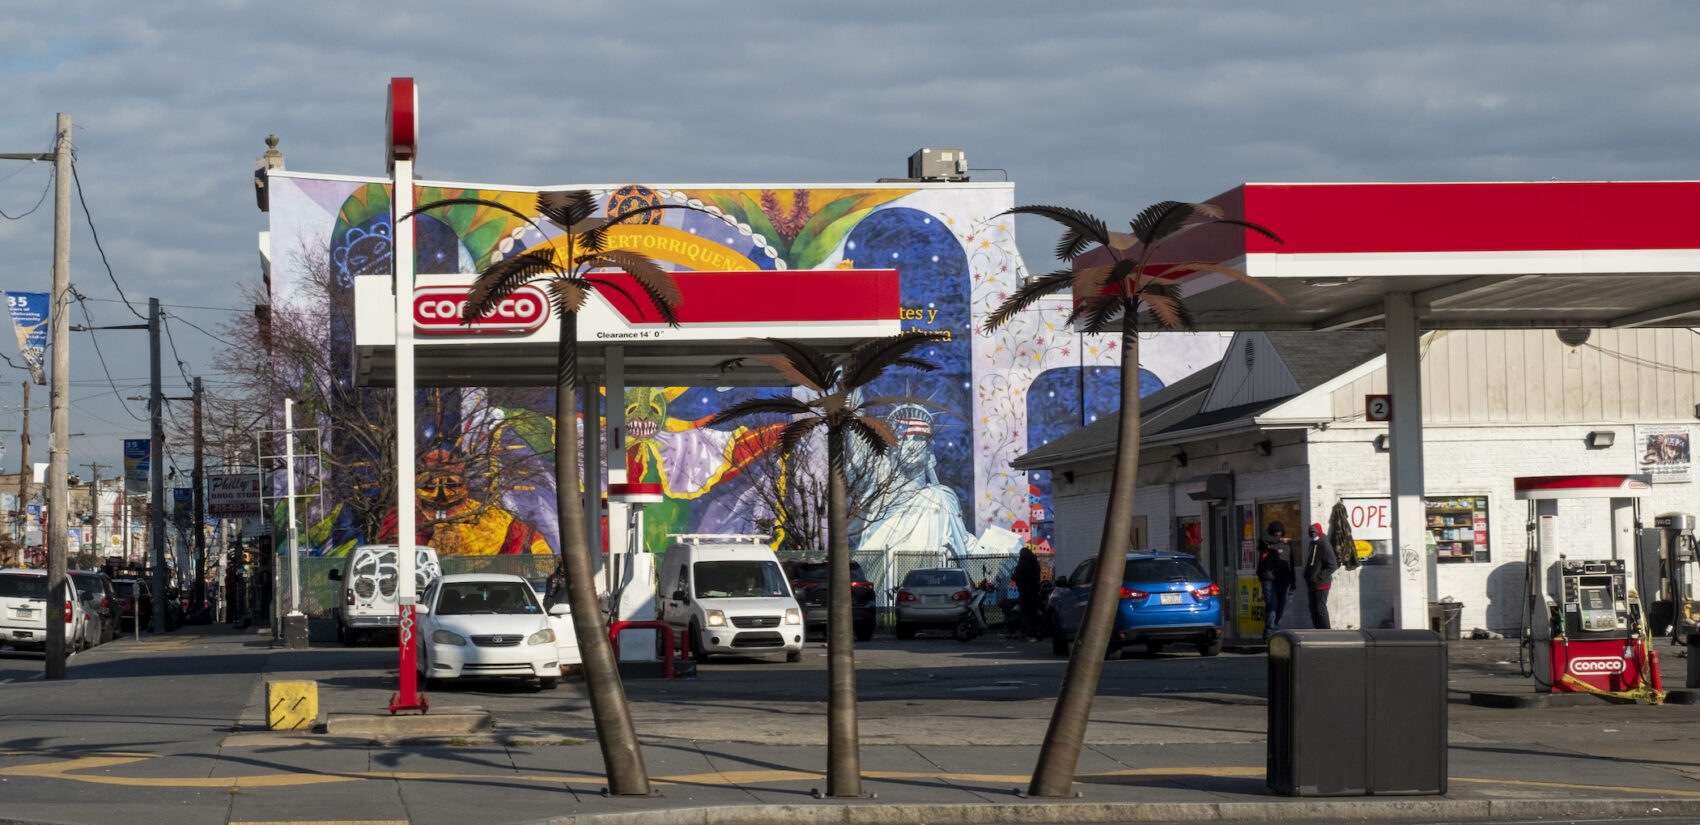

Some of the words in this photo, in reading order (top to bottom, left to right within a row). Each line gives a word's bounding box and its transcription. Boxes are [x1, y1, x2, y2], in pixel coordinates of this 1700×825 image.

[600, 234, 747, 271] ERTORRIQUEÑ
[8, 296, 28, 307] 35
[900, 306, 923, 320] tes
[927, 309, 938, 324] y
[1375, 402, 1384, 414] 2
[211, 477, 247, 491] Philly
[1351, 505, 1393, 528] OPE
[1251, 605, 1266, 621] HER
[1574, 660, 1622, 670] conoco
